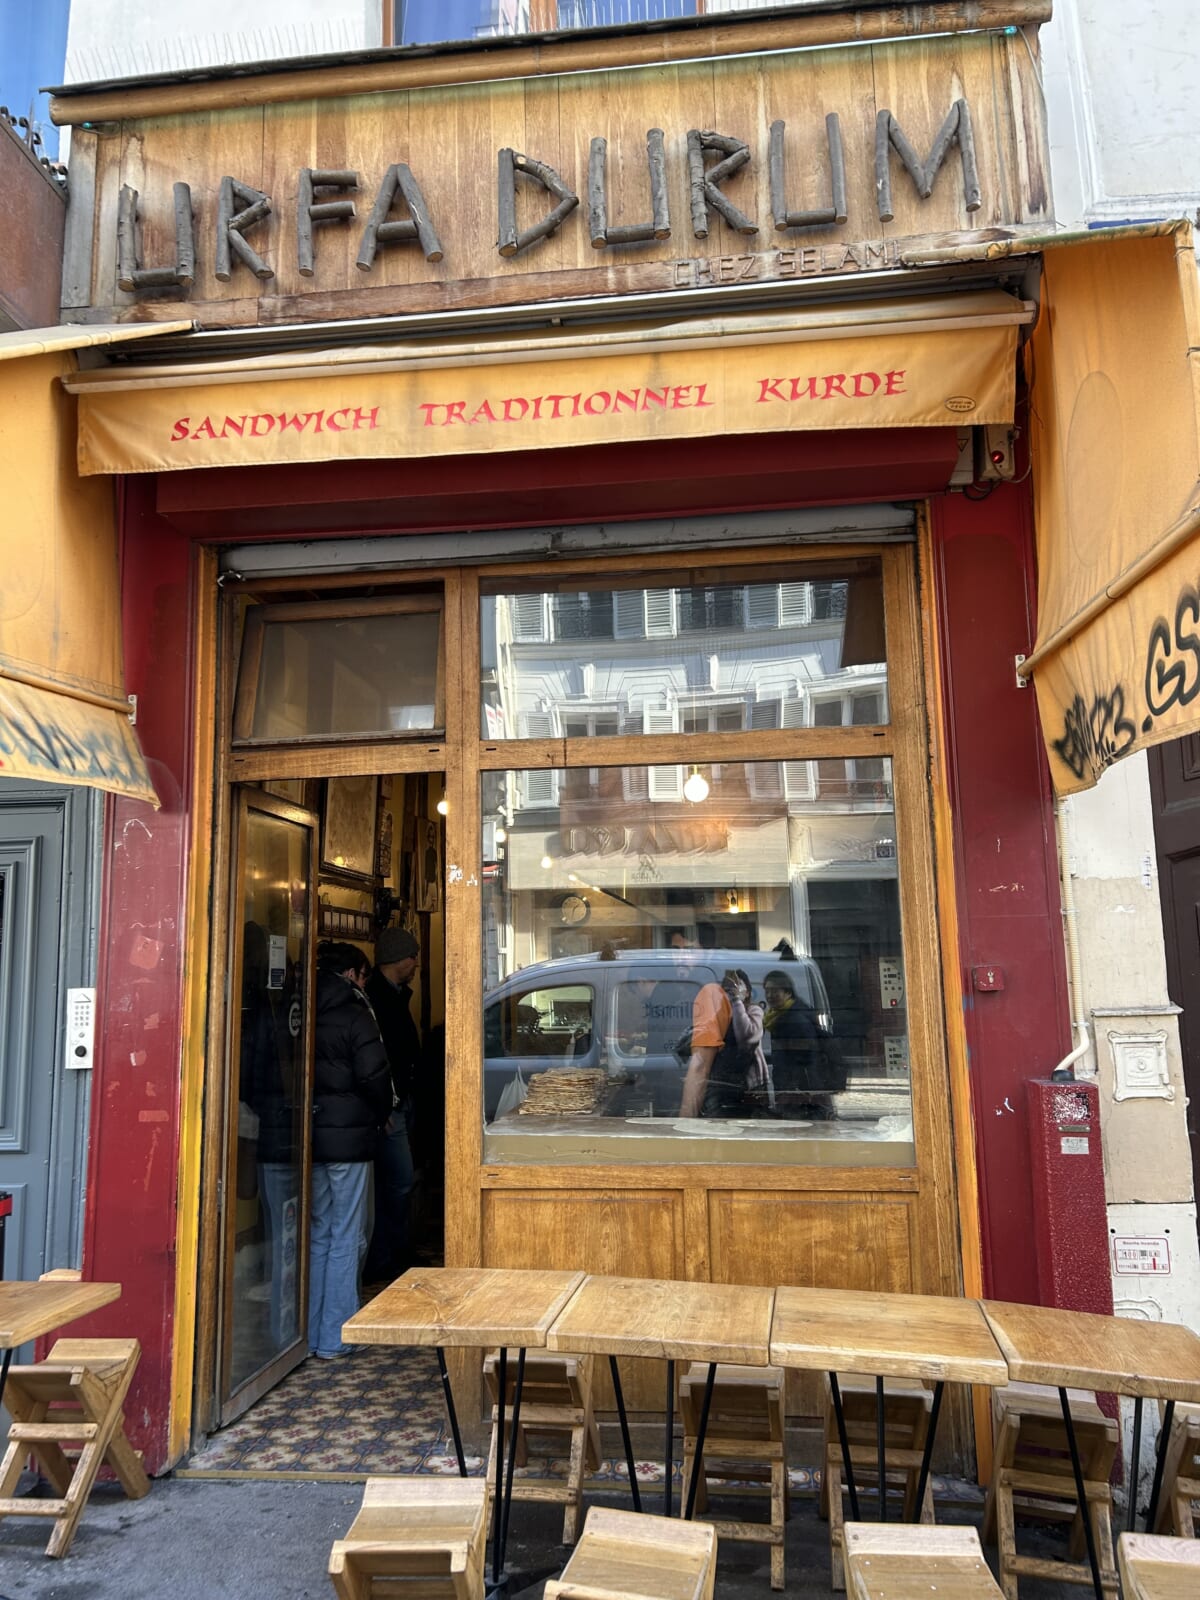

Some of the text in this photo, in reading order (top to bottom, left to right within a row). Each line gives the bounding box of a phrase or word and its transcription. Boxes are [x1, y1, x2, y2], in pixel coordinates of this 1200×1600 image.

[118, 98, 983, 292] URFA DURUM
[674, 239, 900, 287] CHEZ SELAMI
[171, 369, 907, 442] SANDWICH TRADITIONNEL KURDE
